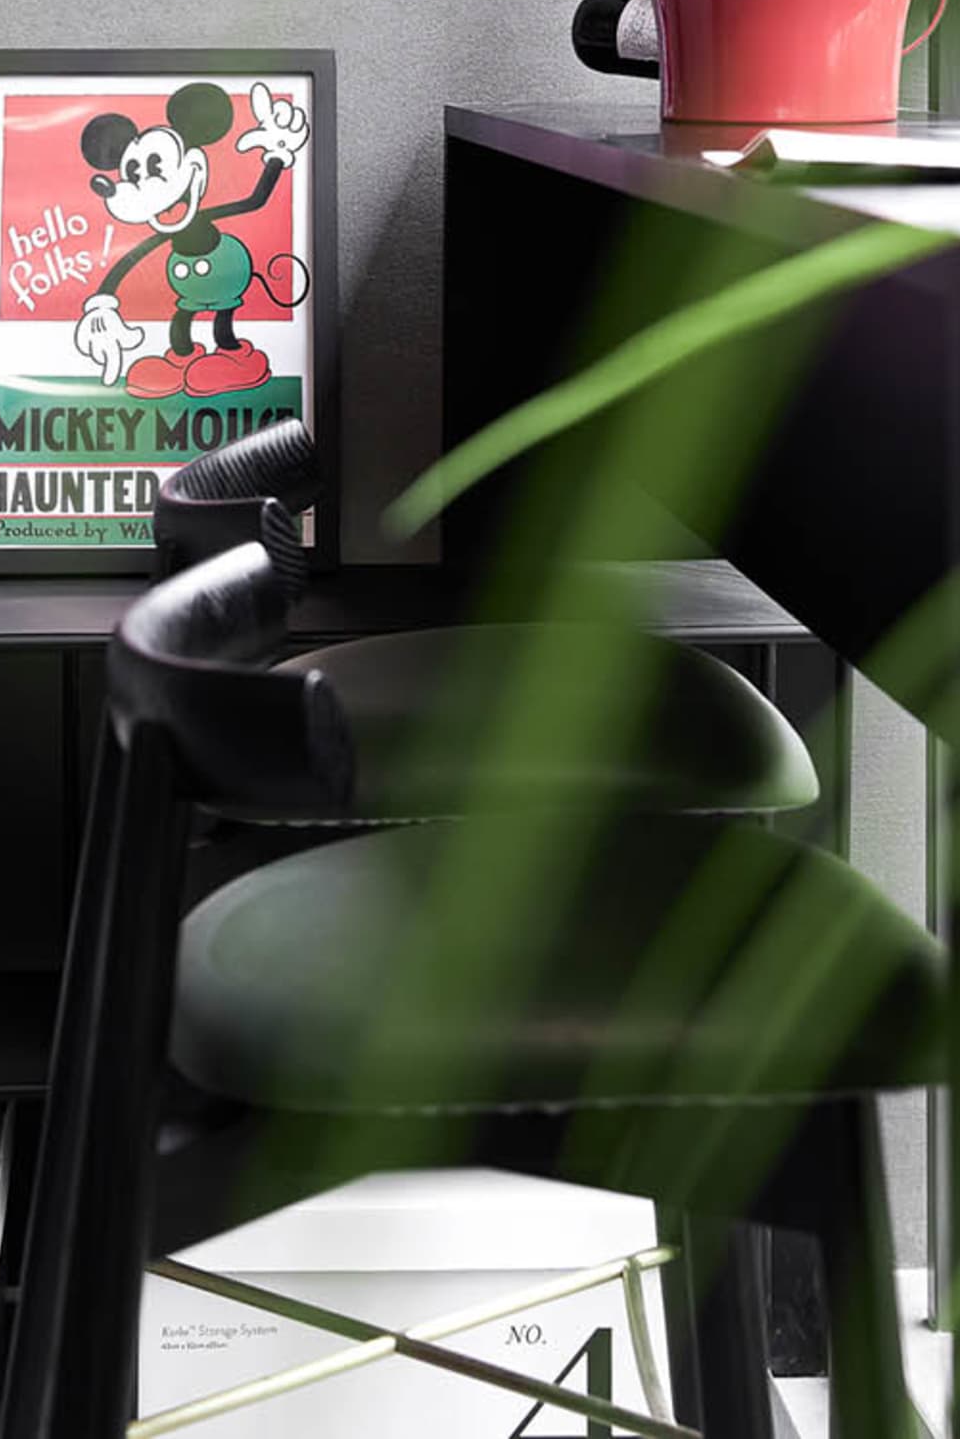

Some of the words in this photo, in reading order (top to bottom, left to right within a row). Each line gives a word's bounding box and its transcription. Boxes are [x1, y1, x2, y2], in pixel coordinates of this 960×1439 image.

[8, 204, 89, 259] hello
[155, 407, 296, 452] MOU
[83, 520, 109, 542] by
[119, 522, 152, 540] WA
[505, 1324, 547, 1345] NO.
